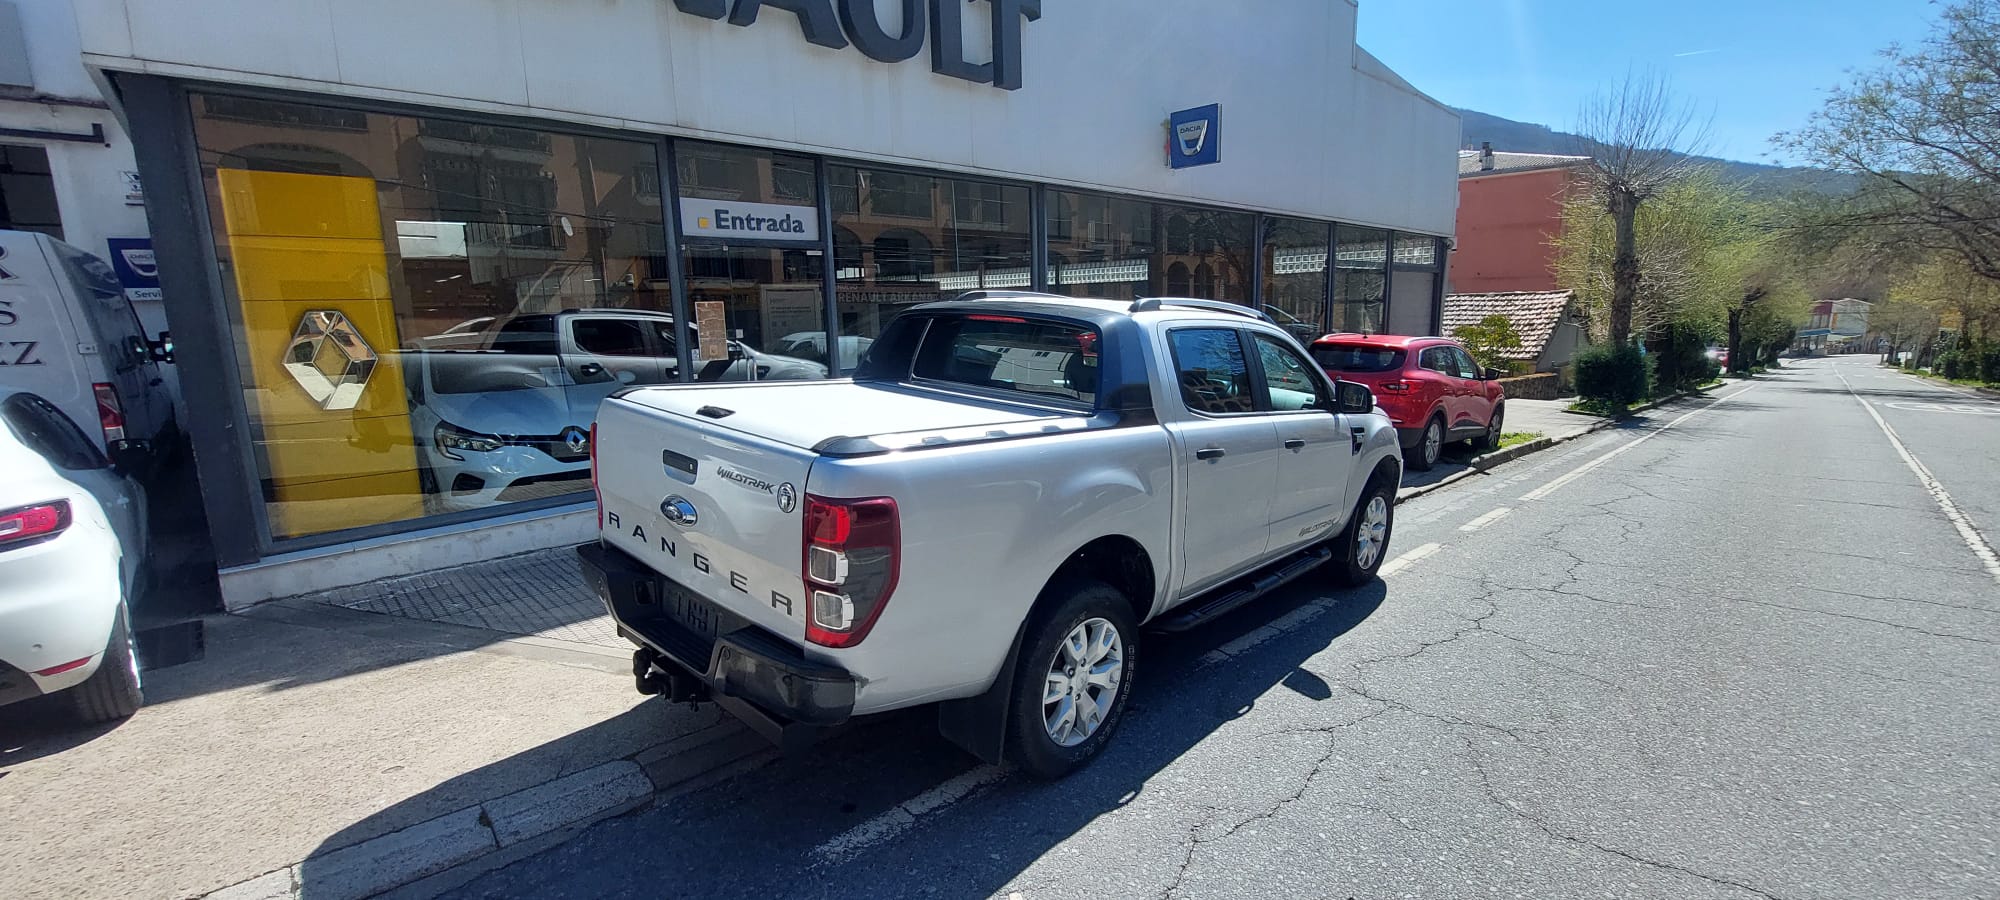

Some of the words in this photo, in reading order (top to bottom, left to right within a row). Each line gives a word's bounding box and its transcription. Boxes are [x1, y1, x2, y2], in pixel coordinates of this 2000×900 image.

[674, 0, 1041, 91] AULT
[1180, 126, 1201, 134] DACIA
[715, 209, 805, 234] Entrada
[838, 292, 887, 303] RENAULT
[716, 466, 776, 494] WILDTRAK
[608, 511, 793, 616] RANGER
